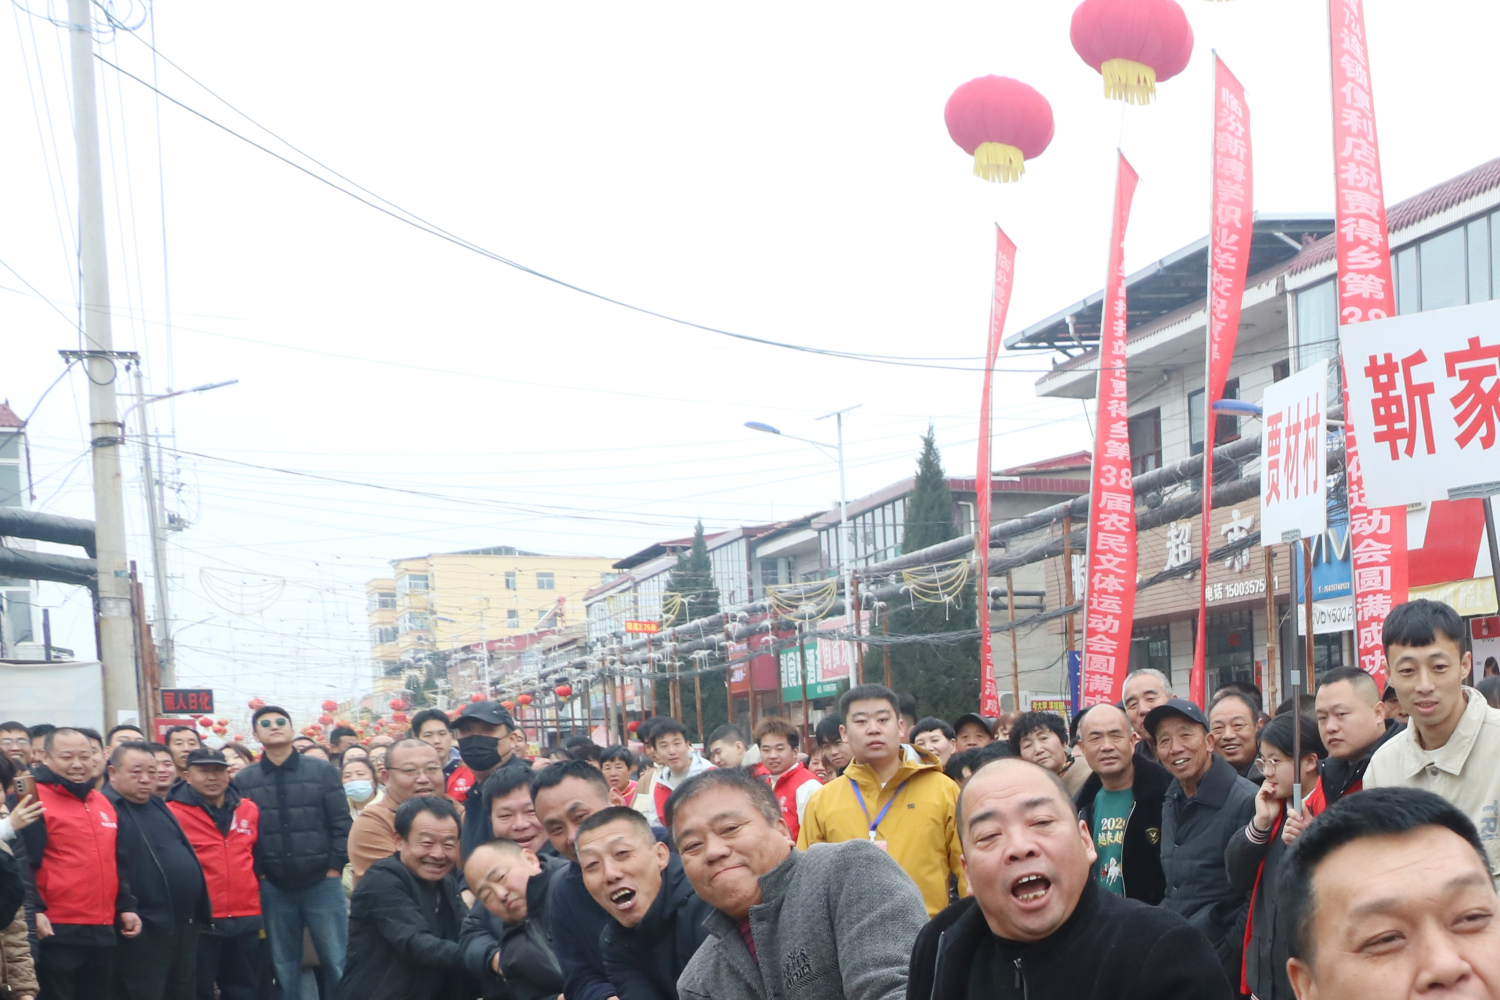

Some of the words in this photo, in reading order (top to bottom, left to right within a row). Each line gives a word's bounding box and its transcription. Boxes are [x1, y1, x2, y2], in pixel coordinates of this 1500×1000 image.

[1265, 391, 1321, 508] 贾材村
[1205, 582, 1223, 602] 电话
[1225, 576, 1279, 598] 150035751
[163, 692, 212, 711] 丽人日化
